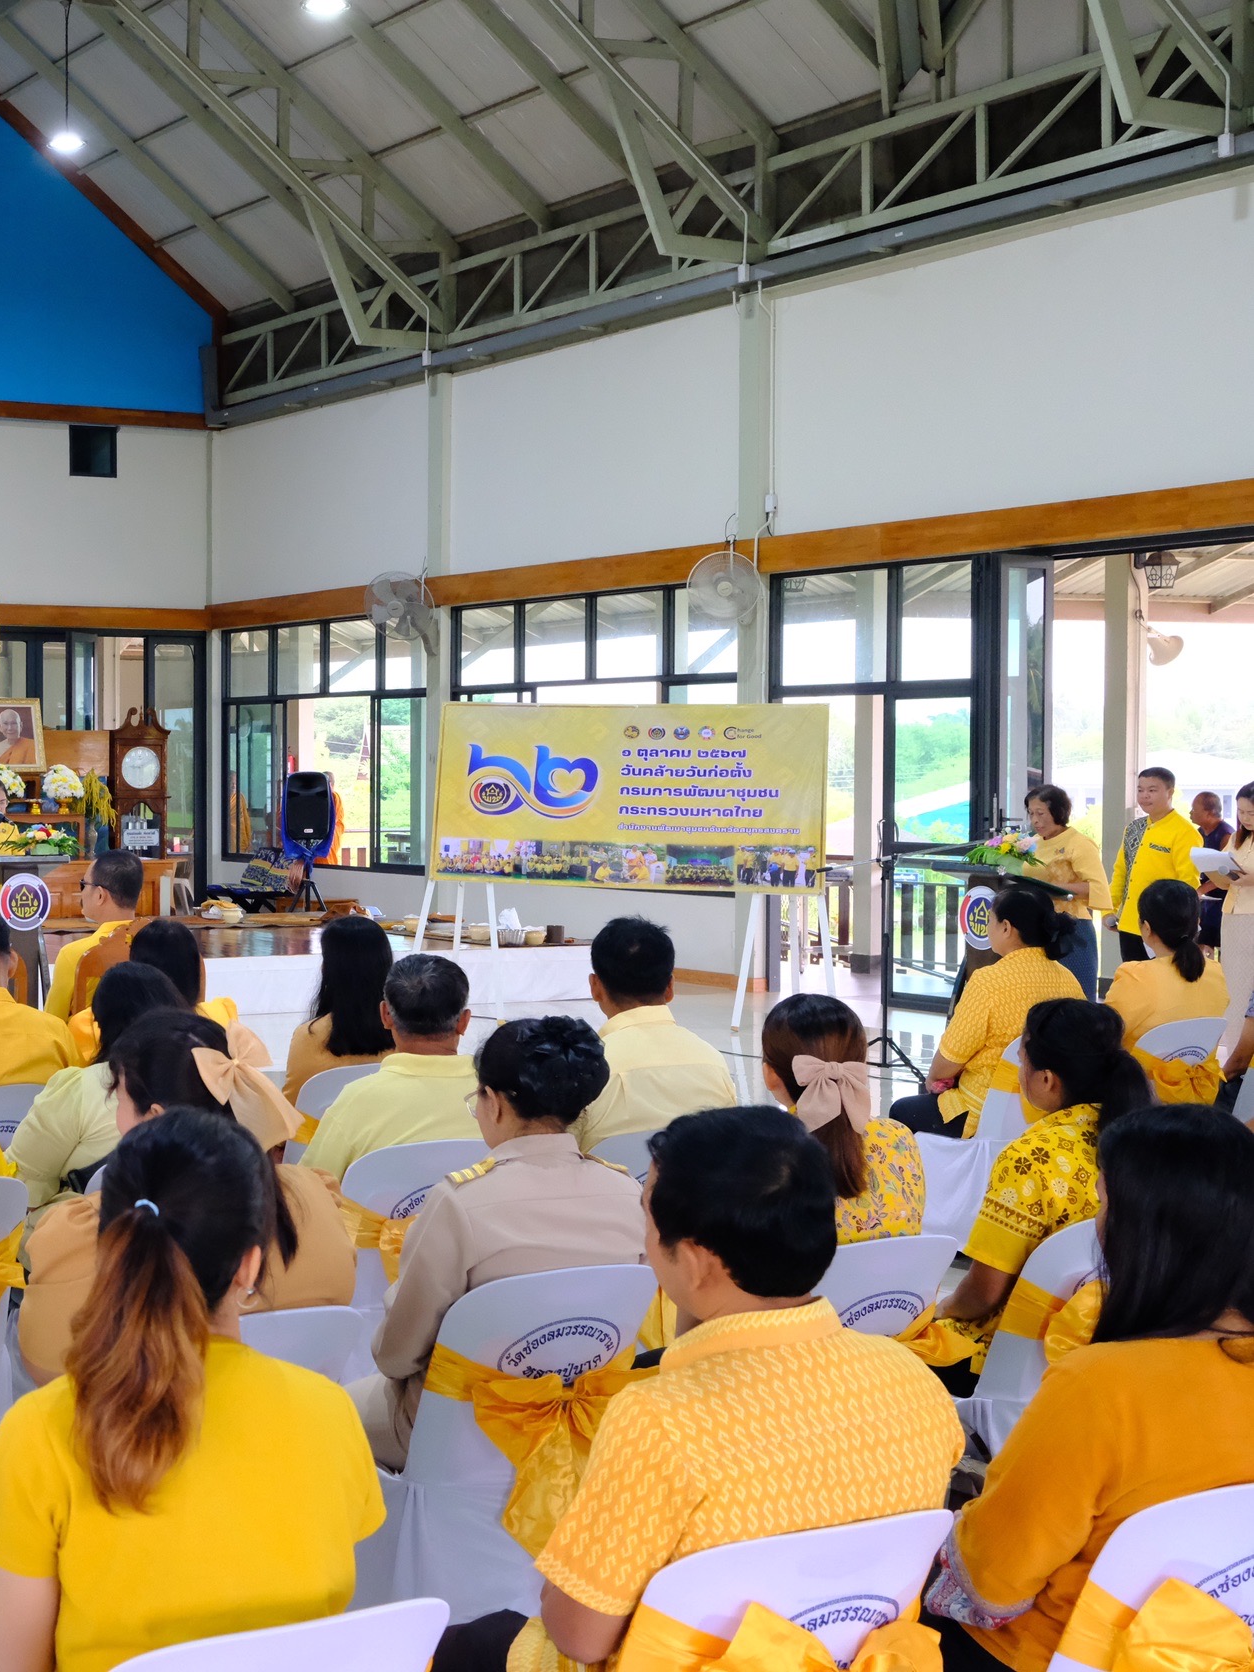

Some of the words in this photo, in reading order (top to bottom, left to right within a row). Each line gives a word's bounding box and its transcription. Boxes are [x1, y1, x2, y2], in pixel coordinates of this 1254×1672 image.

[637, 747, 692, 761] ตุลาคม
[697, 748, 747, 759] ๒๕๖๗
[620, 762, 753, 779] วันคล้ายวันก่อตั้ง
[619, 785, 780, 802] กรมการพัฒนาชุมชน
[618, 804, 764, 818] กระทรวงมหาดไทย
[506, 1324, 614, 1367] วัดช่องลมวรรณาราม
